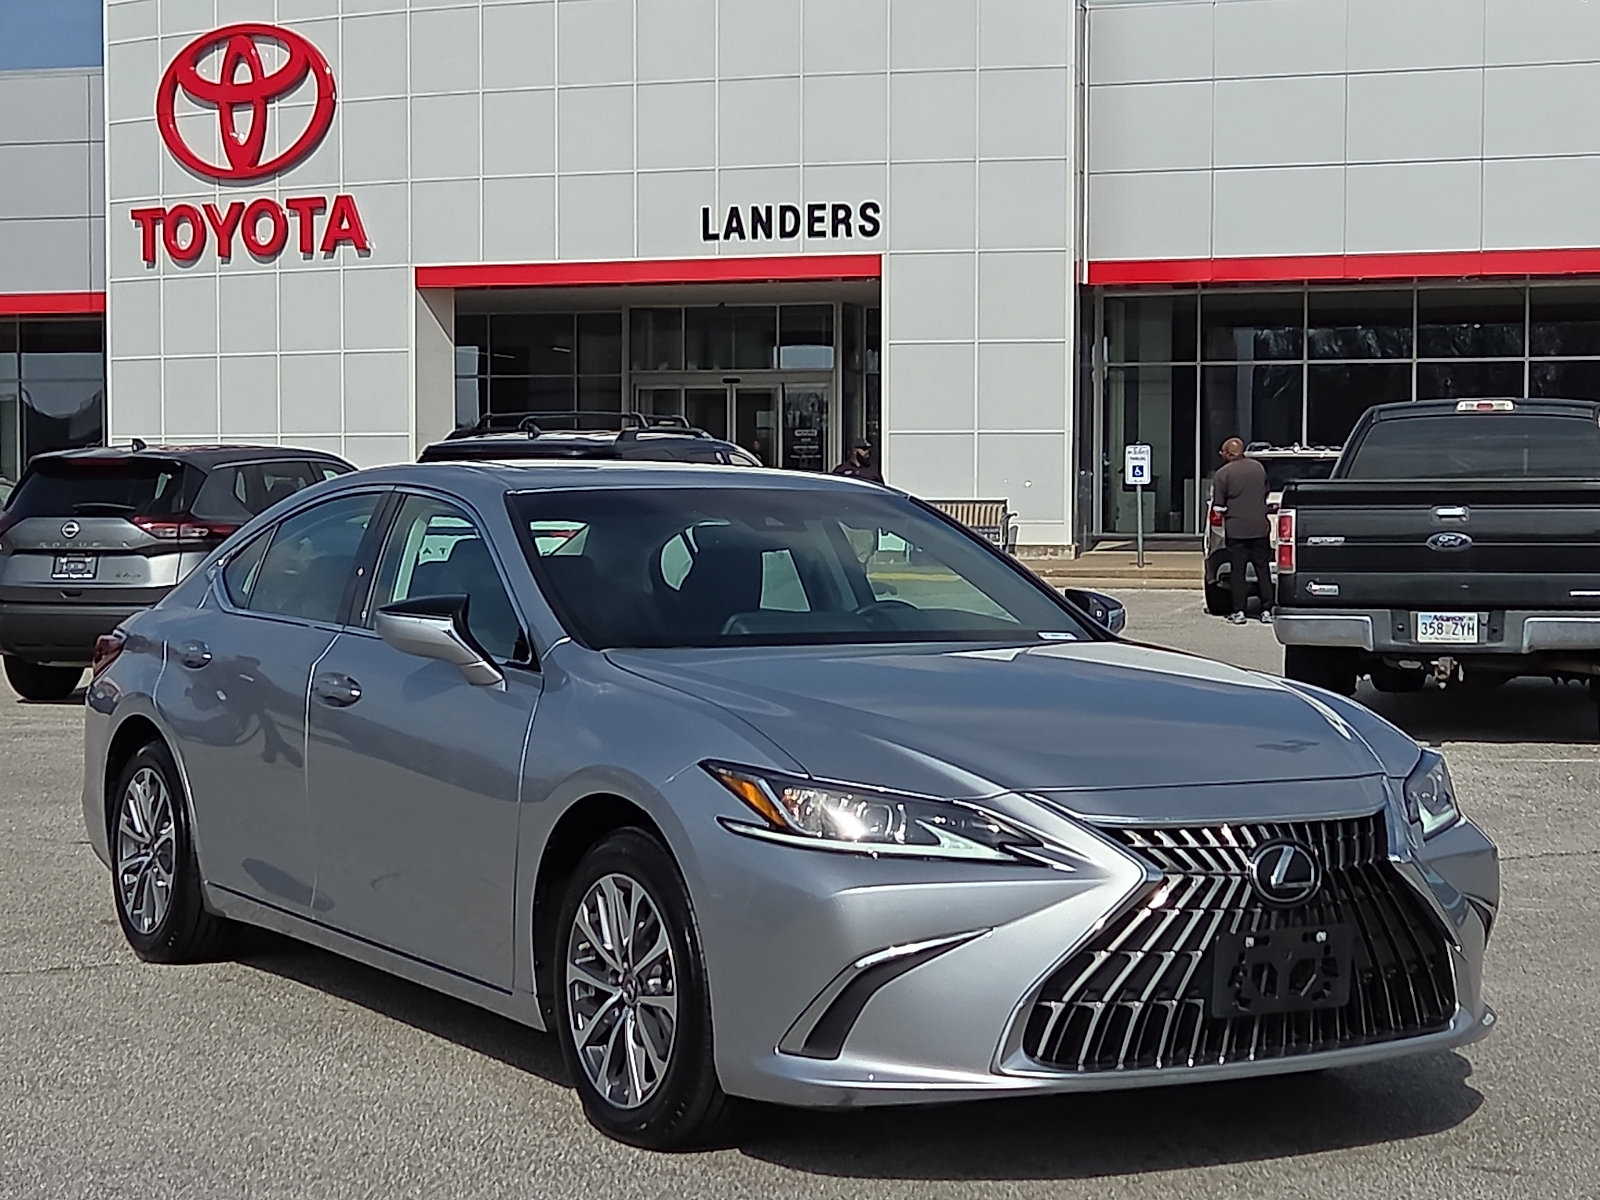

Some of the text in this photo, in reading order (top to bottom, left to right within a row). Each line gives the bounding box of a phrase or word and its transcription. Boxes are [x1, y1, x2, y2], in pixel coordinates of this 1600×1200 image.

[131, 195, 369, 266] TOYOTA
[702, 202, 881, 241] LANDERS
[1421, 621, 1475, 636] 358 ZYH
